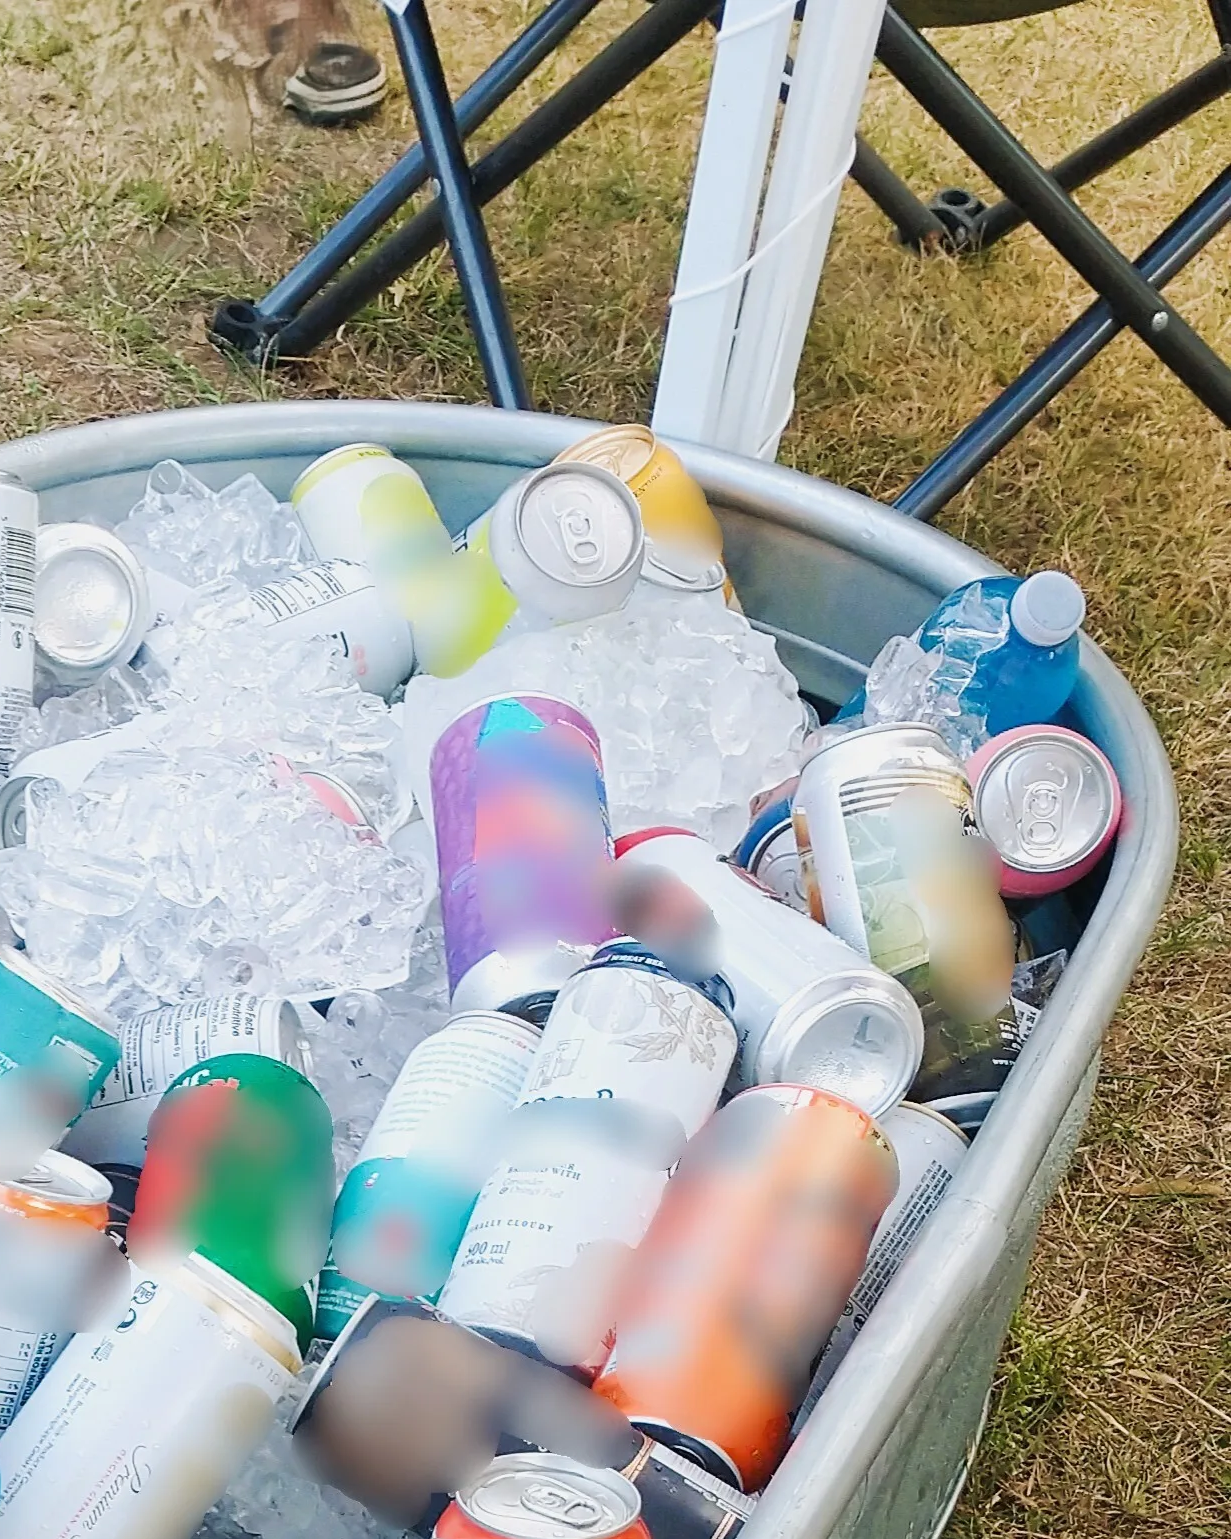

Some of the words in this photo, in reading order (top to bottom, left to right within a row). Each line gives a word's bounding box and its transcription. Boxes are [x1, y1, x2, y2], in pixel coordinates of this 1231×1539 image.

[507, 1219, 553, 1232] CLOUDY
[31, 1355, 40, 1373] FOR
[83, 1445, 151, 1530] Premium
